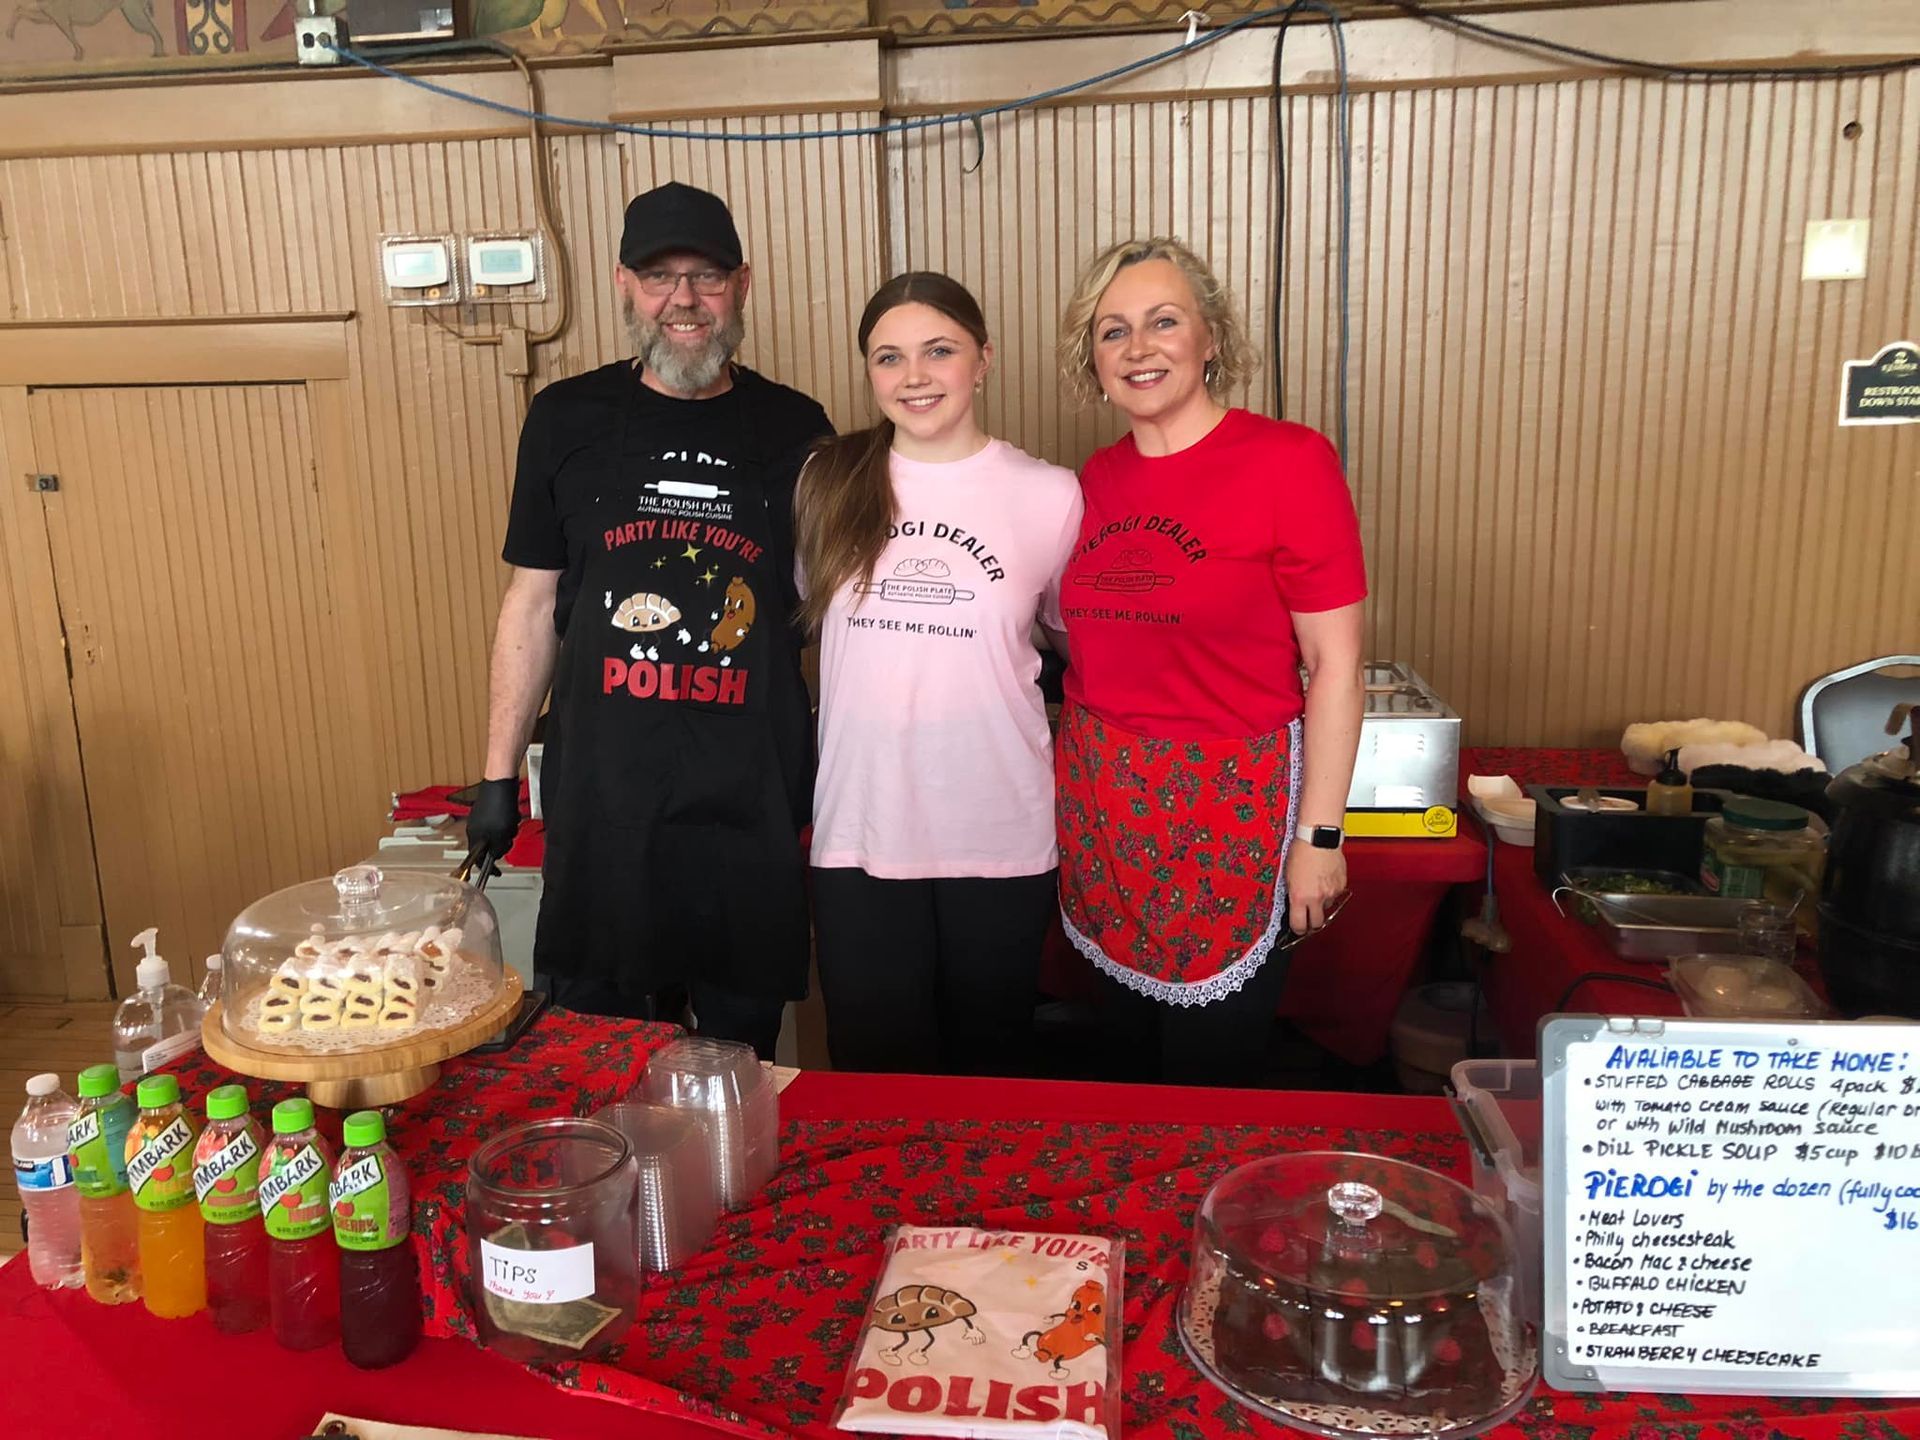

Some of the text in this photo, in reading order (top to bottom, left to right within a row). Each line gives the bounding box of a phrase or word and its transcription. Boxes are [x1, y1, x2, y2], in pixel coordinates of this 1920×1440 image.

[1859, 397, 1895, 408] DOWN
[637, 506, 733, 521] AUTHENTIC POLISH CUISINE
[638, 496, 733, 514] THE POLISH PLATE
[604, 520, 764, 564] PARTY LIKE YOU'RE
[1144, 515, 1207, 565] DEALER
[933, 523, 1005, 582] DEALER
[1065, 608, 1089, 618] THEY
[1092, 608, 1112, 620] SEE
[1115, 610, 1132, 620] ME
[847, 617, 875, 629] THEY
[879, 619, 902, 631] SEE
[906, 622, 925, 634] ME
[603, 657, 749, 705] POLISH
[1733, 1051, 1760, 1069] TO
[1768, 1050, 1822, 1070] TAKE
[1595, 1074, 1668, 1090] STUFFED
[1678, 1074, 1754, 1090] CABBAGE
[1763, 1073, 1816, 1091] ROLLS
[1595, 1099, 1626, 1114] with
[1635, 1100, 1692, 1114] Tomato
[66, 1117, 95, 1149] ARK
[1597, 1118, 1617, 1130] or
[1626, 1116, 1660, 1132] with
[1715, 1119, 1802, 1136] Mushroom
[130, 1123, 188, 1183] YMBARK
[1643, 1139, 1713, 1159] PICKLE
[1722, 1142, 1778, 1161] SOUP
[331, 1162, 376, 1202] MBARK
[1707, 1178, 1728, 1204] by
[1732, 1178, 1765, 1198] the
[1772, 1178, 1831, 1197] dozen
[1588, 1209, 1684, 1228] Meat Lovers
[895, 1230, 1111, 1268] ARTY LIKE YOU'R
[1585, 1229, 1624, 1257] Philly
[1076, 1260, 1089, 1272] S
[1584, 1252, 1633, 1270] Bacon
[1640, 1253, 1673, 1270] Mac
[1690, 1253, 1753, 1272] cheese
[1588, 1275, 1660, 1292] BUFFALO
[1580, 1297, 1633, 1315] POTATO
[1649, 1302, 1717, 1319] CHEESE
[1589, 1322, 1685, 1338] BREAKFAST
[1586, 1344, 1821, 1368] STRAWBERRY CHEESECAKE
[853, 1367, 1105, 1425] POLISH
